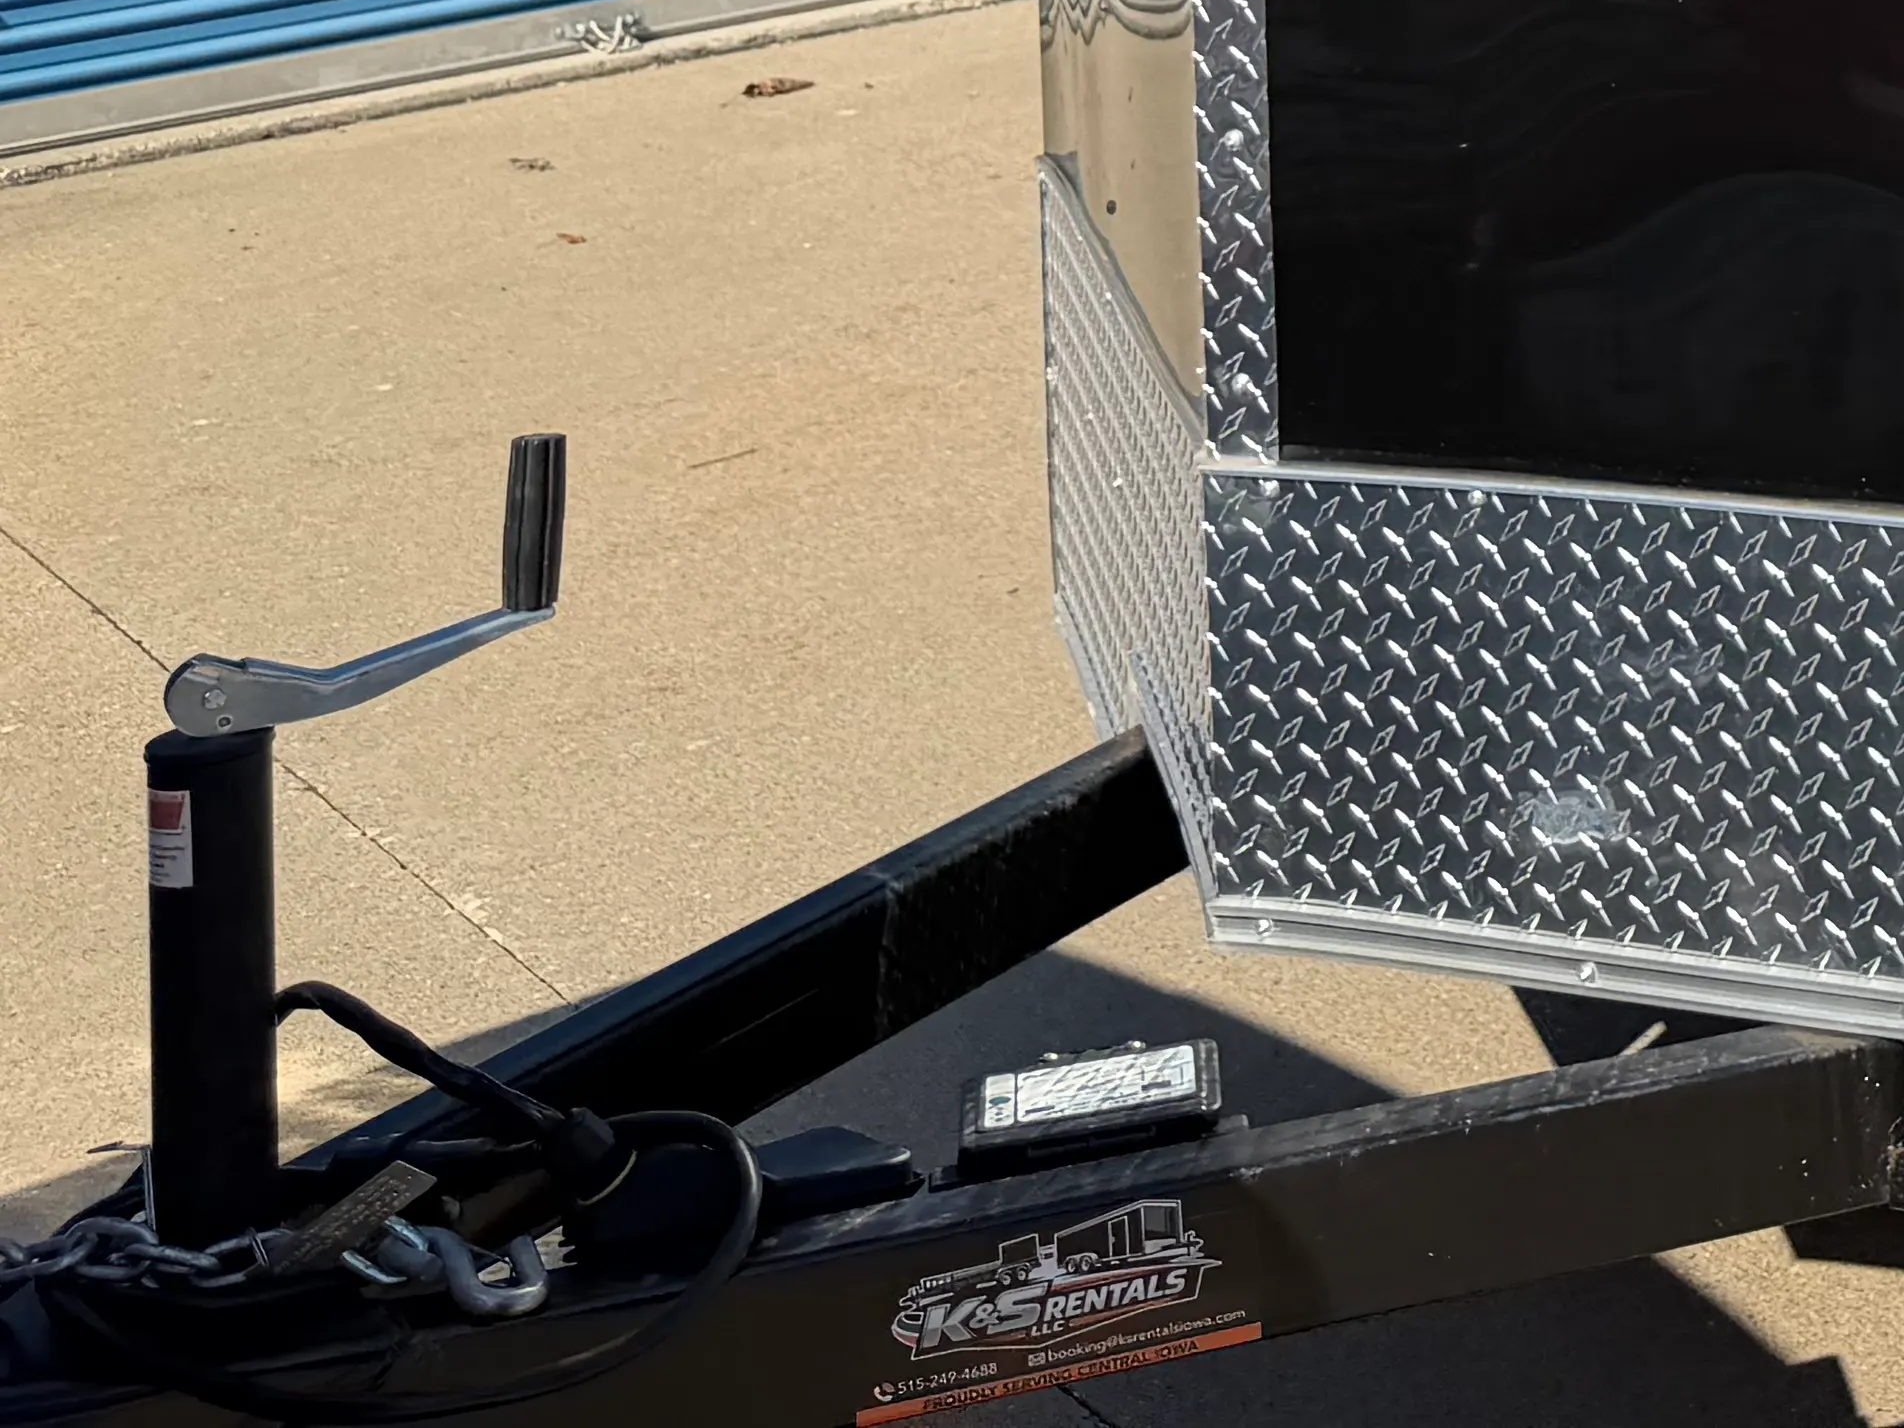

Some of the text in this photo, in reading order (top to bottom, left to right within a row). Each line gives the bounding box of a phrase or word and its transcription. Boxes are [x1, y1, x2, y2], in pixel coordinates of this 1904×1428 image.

[919, 1268, 1188, 1349] K&S RENTALS
[1031, 1319, 1065, 1338] LLC
[897, 1362, 998, 1395] 515-249-4688
[923, 1339, 1200, 1411] PROUDLY SERVING CENTRAL IOWA
